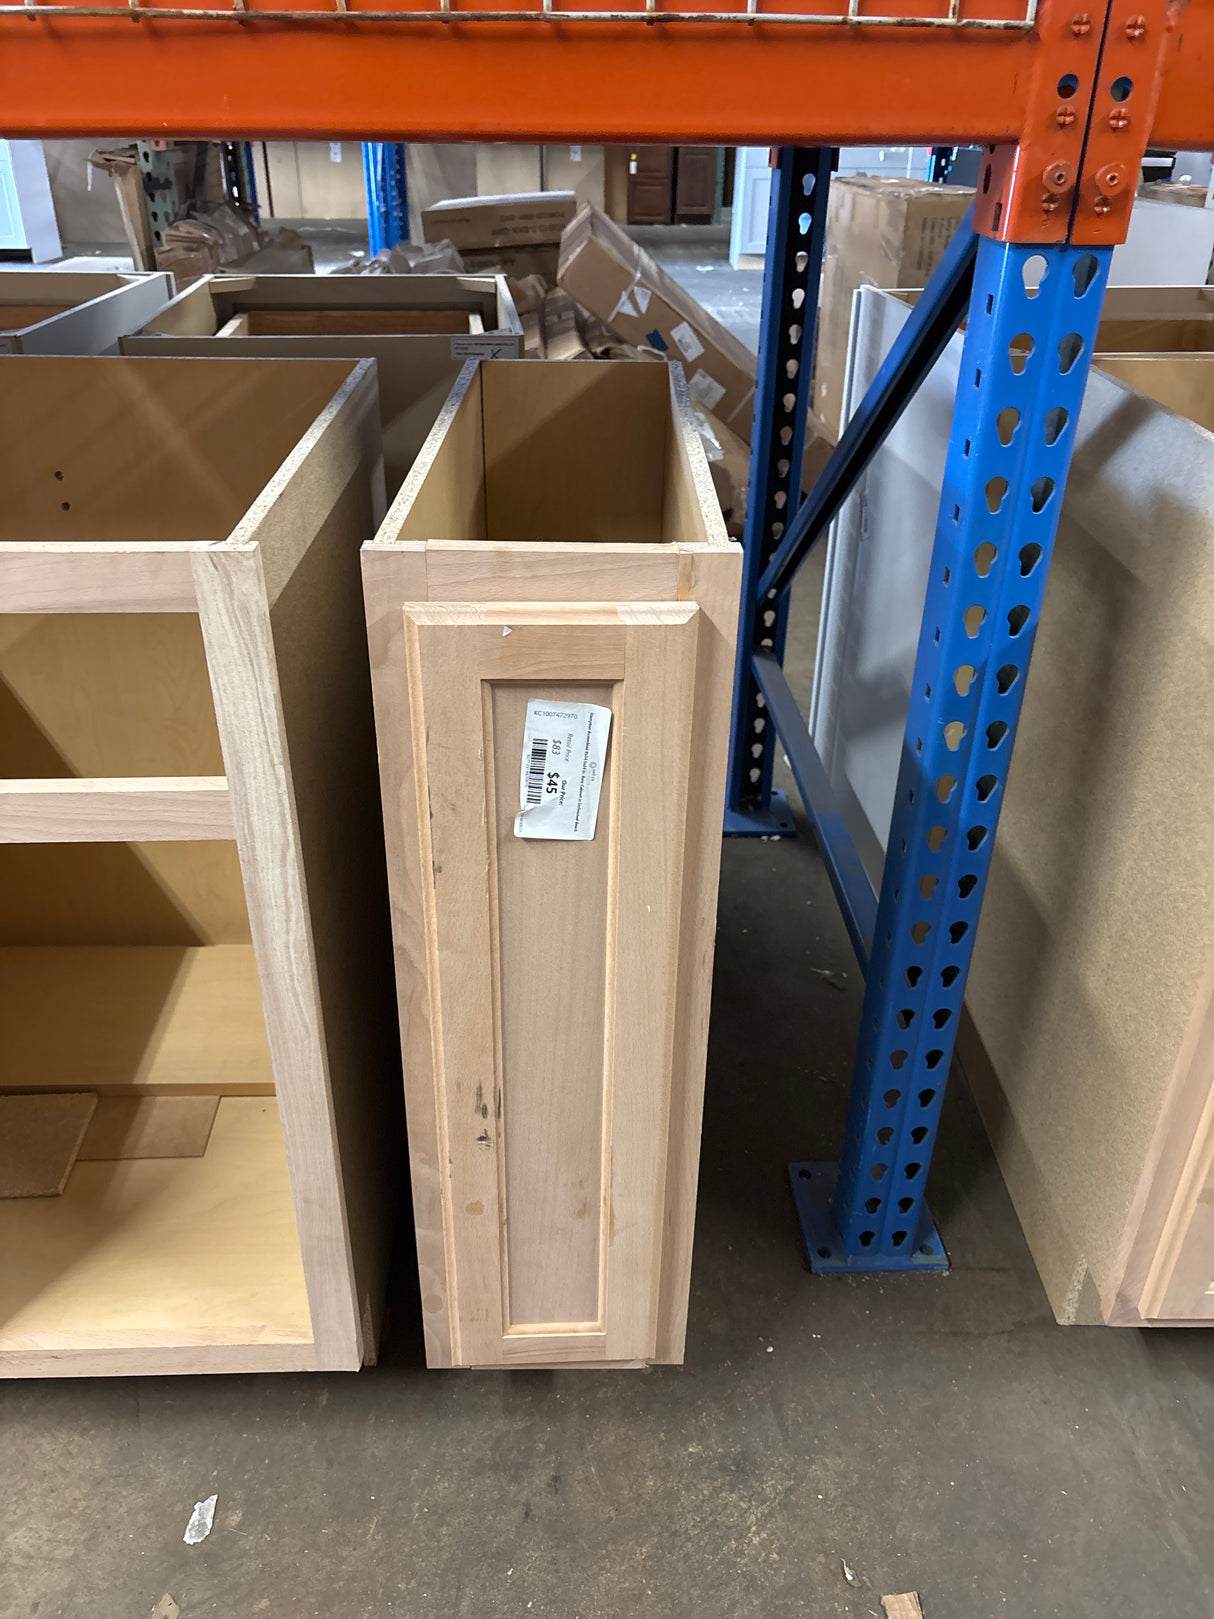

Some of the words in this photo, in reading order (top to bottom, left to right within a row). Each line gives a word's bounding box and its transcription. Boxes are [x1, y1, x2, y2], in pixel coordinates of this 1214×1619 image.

[533, 710, 578, 720] KC1007472970
[551, 739, 562, 756] $83
[566, 733, 574, 749] Retail
[545, 772, 560, 794] $45
